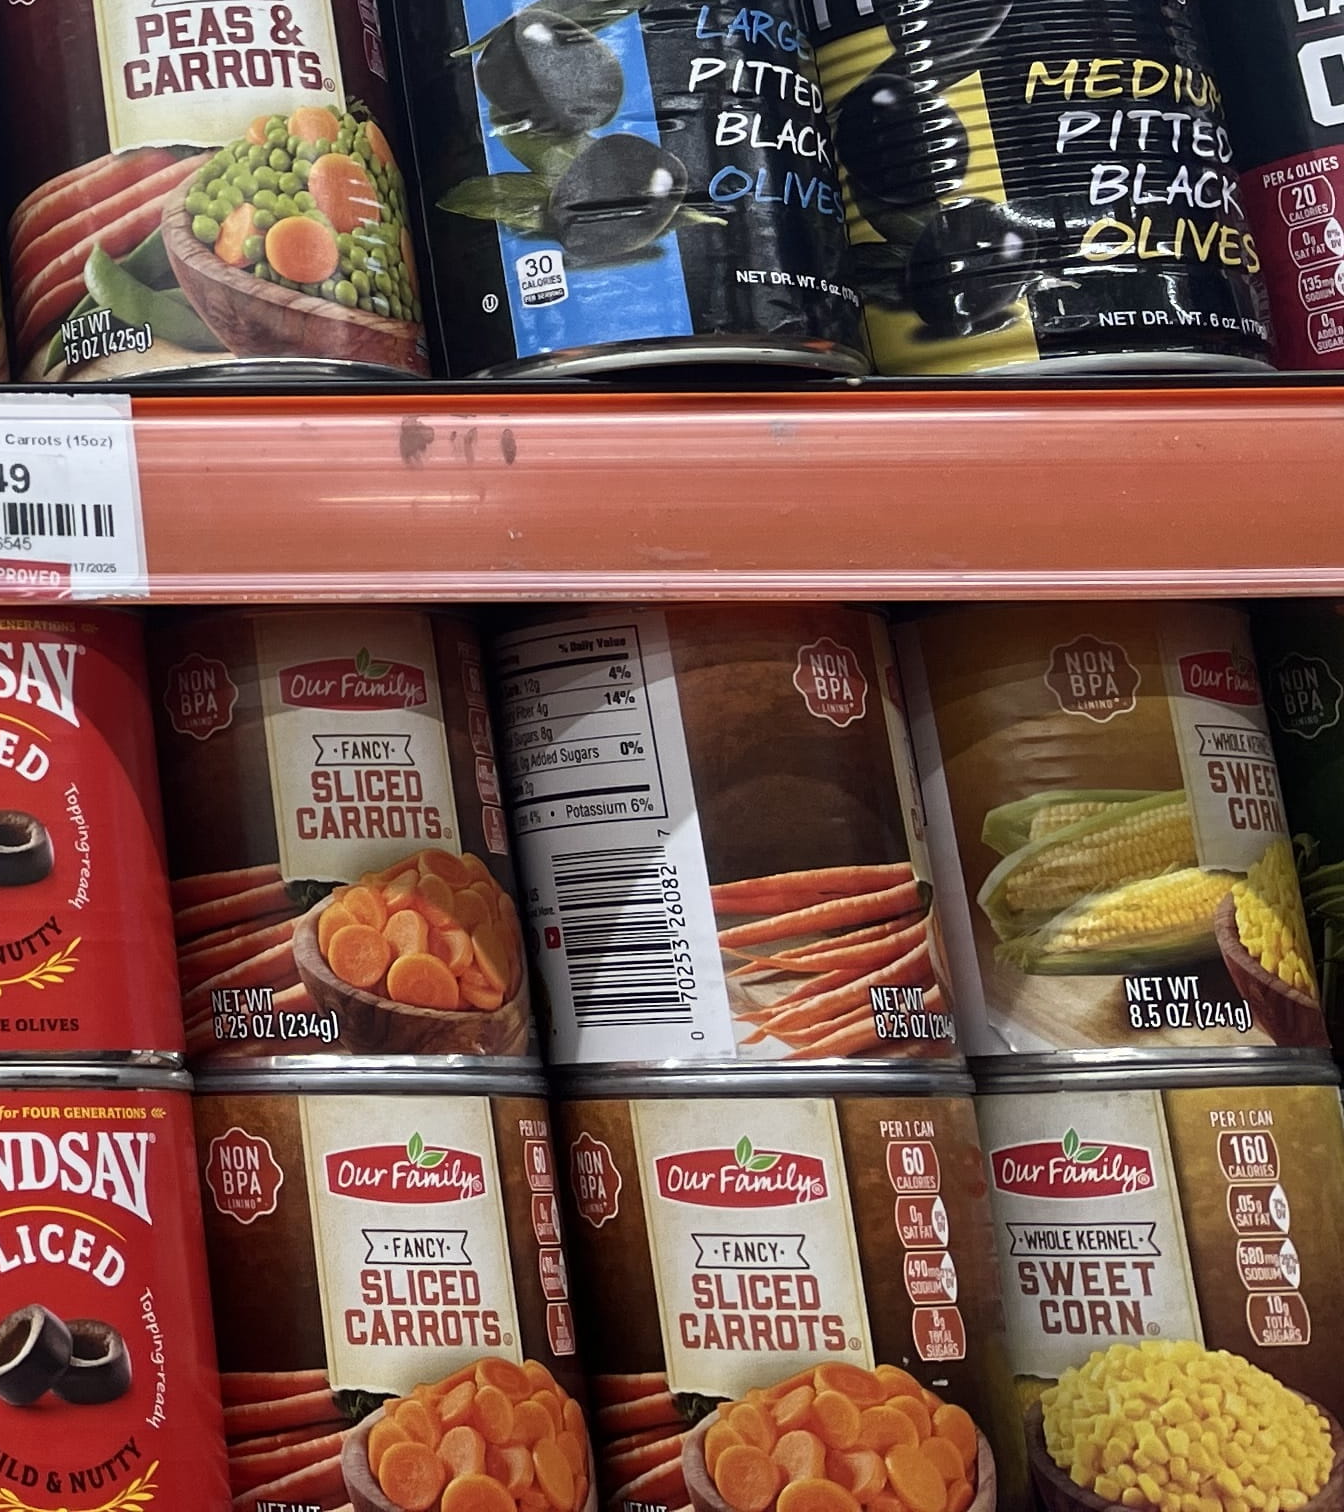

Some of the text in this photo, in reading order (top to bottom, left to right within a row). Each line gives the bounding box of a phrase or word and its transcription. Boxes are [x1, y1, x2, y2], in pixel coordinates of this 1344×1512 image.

[123, 49, 323, 100] CARROTS
[1024, 59, 1223, 115] MEDIUM
[5, 434, 61, 446] Carrots
[66, 435, 113, 449] (15oz)
[1064, 651, 1114, 673] NON
[1071, 674, 1118, 696] BPA
[566, 797, 654, 817] Potassium 6%
[296, 807, 441, 840] CARROTS
[64, 784, 91, 909] Topping-ready
[662, 864, 696, 1003] 70253 26082
[213, 989, 273, 1013] NET WT
[1129, 1001, 1252, 1029] 8.5 OZ (241g)
[13, 1018, 78, 1032] OLIVES
[214, 1013, 339, 1041] 8.25 OZ (234g)
[1211, 1110, 1274, 1127] PER CAN
[1229, 1136, 1269, 1164] 160
[1026, 1230, 1138, 1251] WHOLE KERNEL
[360, 1270, 480, 1306] SLICED
[1019, 1263, 1156, 1297] SWEET
[1041, 1300, 1144, 1335] CORN
